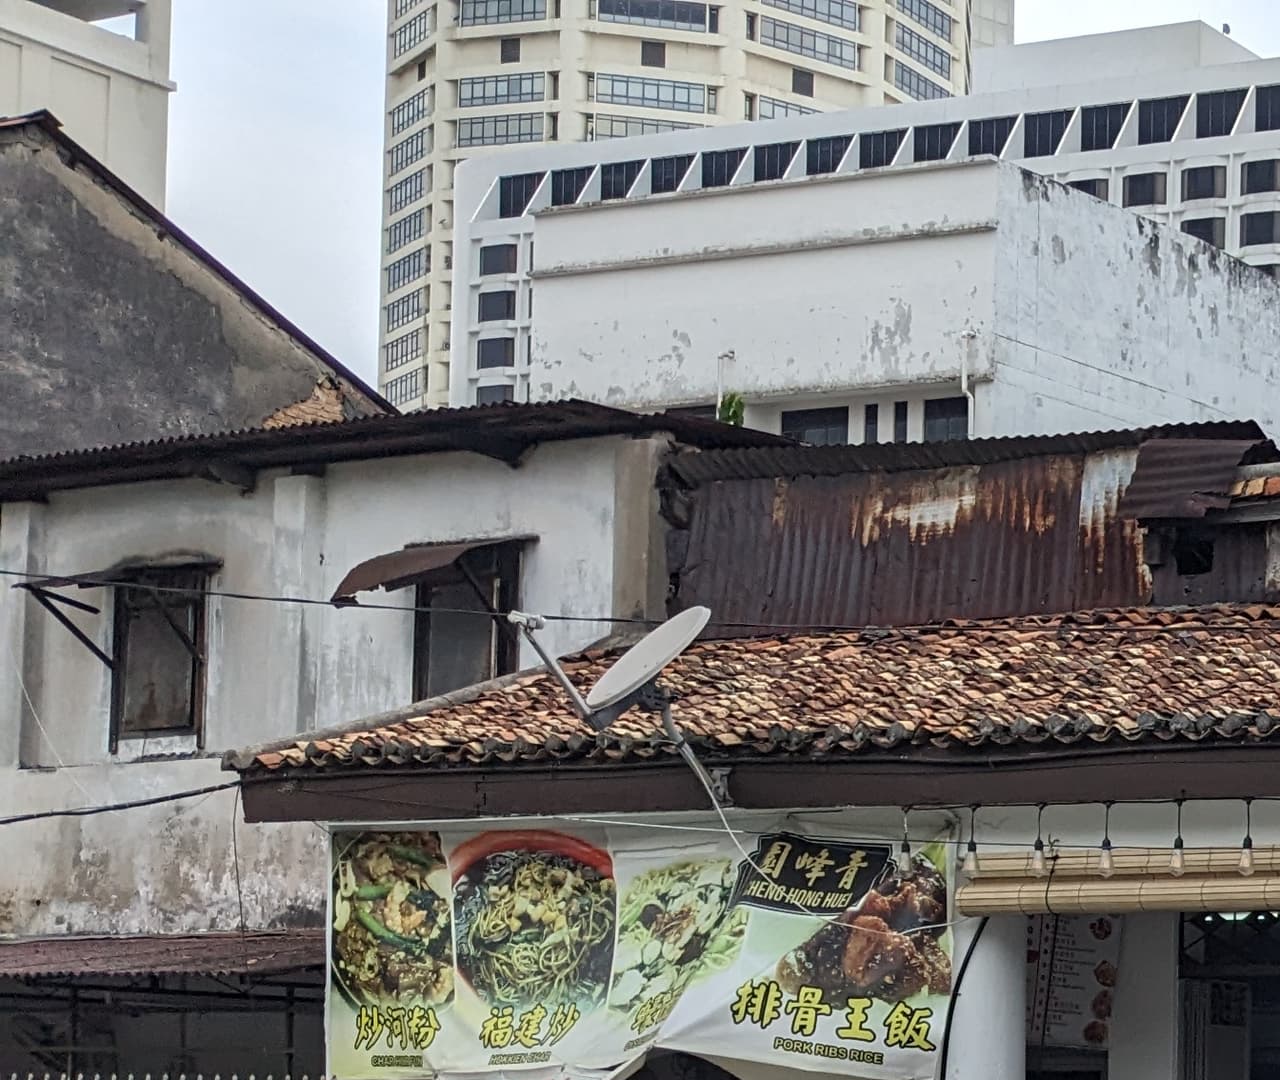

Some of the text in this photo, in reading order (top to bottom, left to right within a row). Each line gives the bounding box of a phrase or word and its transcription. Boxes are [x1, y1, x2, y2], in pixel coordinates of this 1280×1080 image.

[743, 879, 853, 909] HENG HONG HUEI
[354, 1004, 441, 1051] 炒河粉
[479, 1002, 581, 1049] 福建炒
[731, 979, 936, 1051] 排骨王飯
[774, 1037, 884, 1065] PORK RIBS RICE
